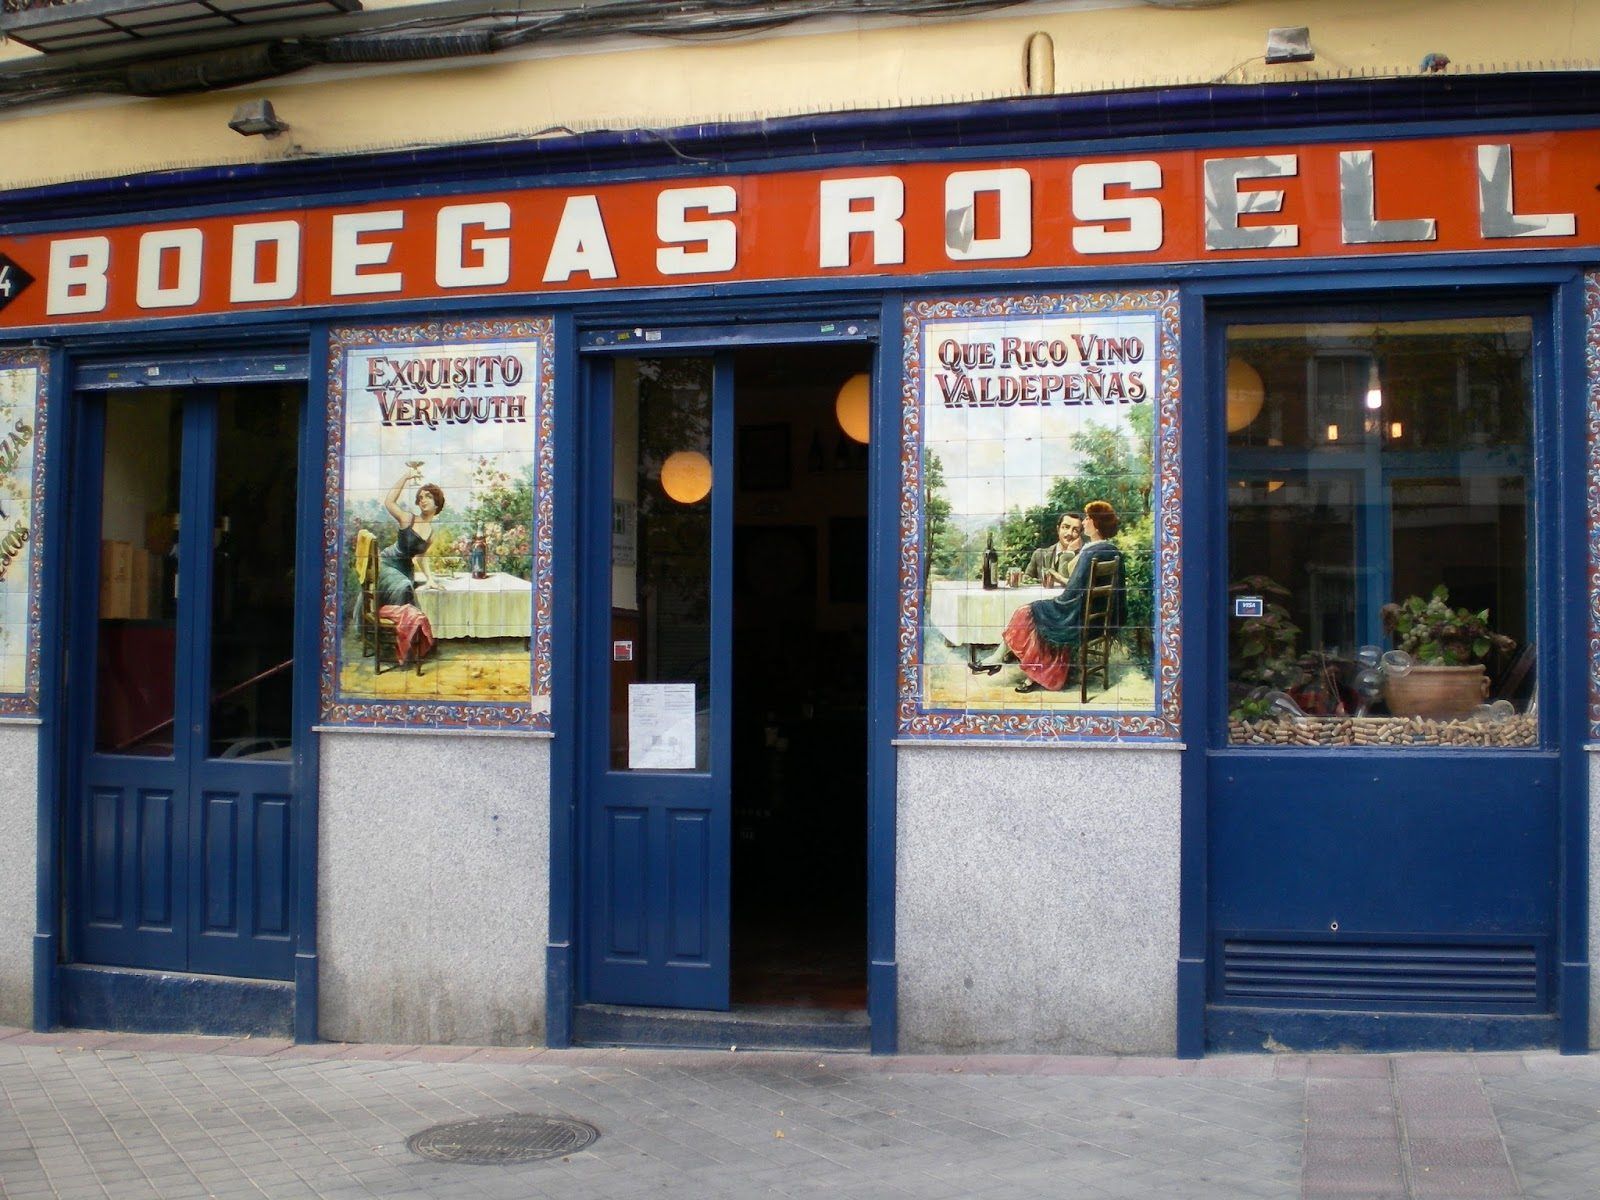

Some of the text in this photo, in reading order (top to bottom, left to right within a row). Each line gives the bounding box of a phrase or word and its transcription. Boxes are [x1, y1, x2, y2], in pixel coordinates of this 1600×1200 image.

[46, 144, 1576, 316] BODEGAS ROSELL
[366, 355, 523, 394] EXQUISITO
[938, 334, 1145, 374] QUE RICO VINO
[935, 366, 1147, 408] VALDEPEÑAS
[373, 390, 527, 431] VERMOUTH
[0, 418, 33, 472] ZAS
